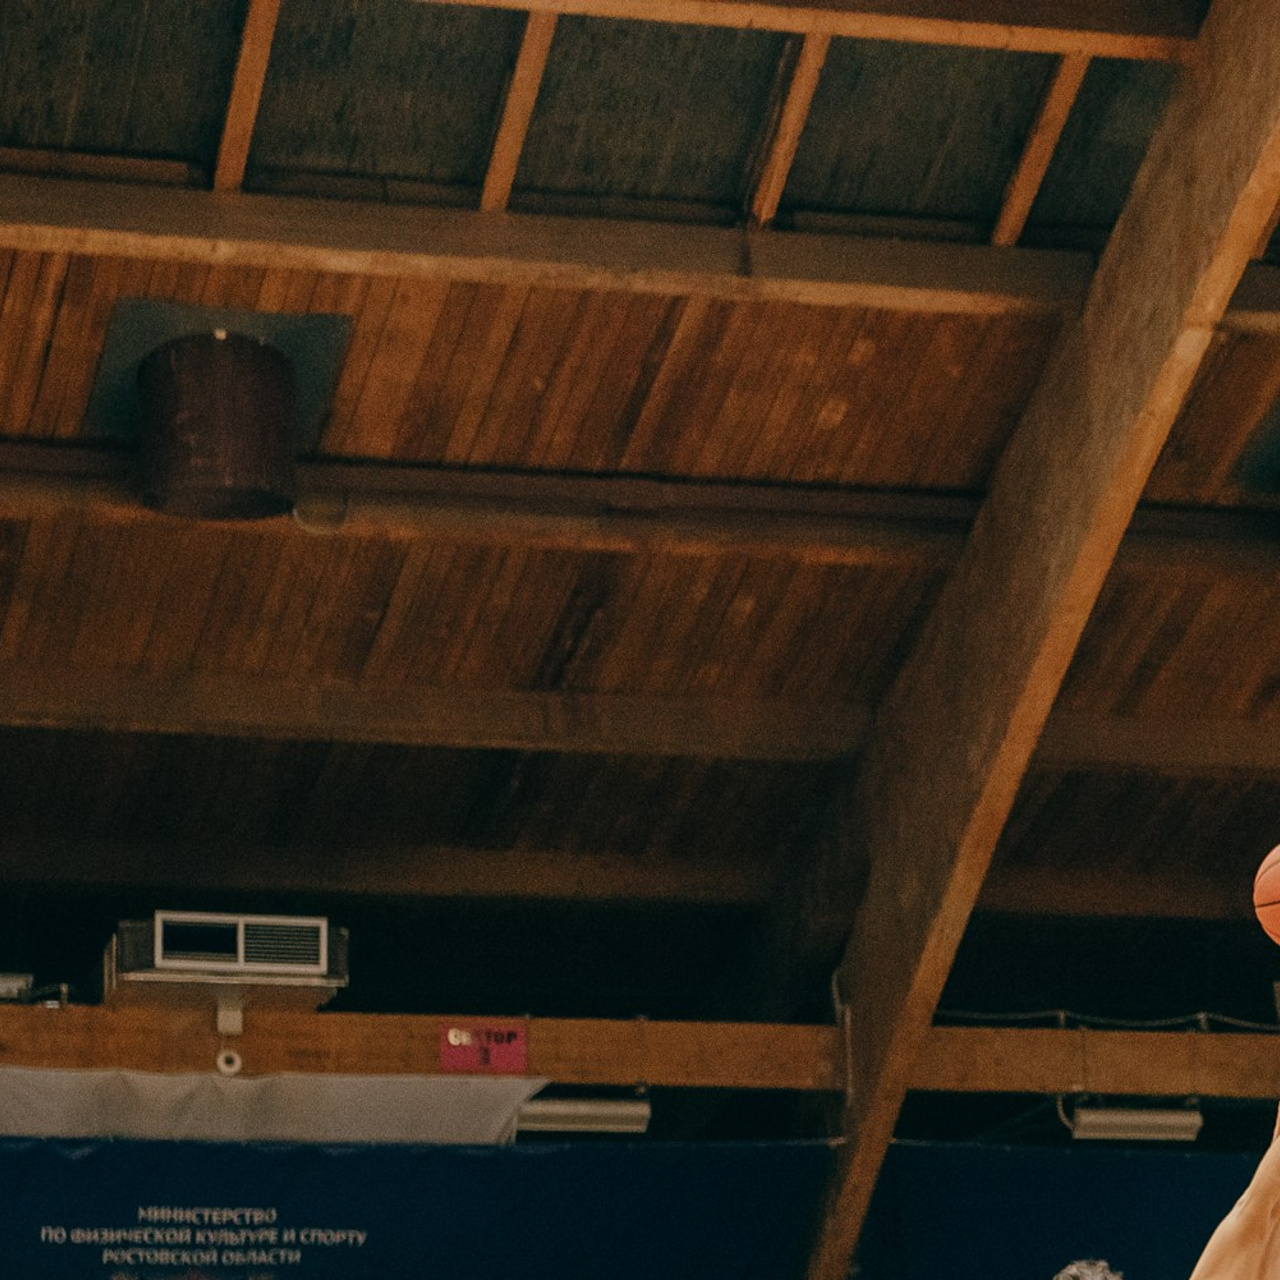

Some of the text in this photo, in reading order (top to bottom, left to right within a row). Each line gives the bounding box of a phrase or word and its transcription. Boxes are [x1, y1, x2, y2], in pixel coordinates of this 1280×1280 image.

[137, 1207, 277, 1225] МИНИСТЕРСТВО
[41, 1226, 367, 1247] ПО ФИЗИЧЕСКОЙ КУЛЬТУРЕ И СПОРТУ
[102, 1248, 302, 1266] РОСТОВСКОЙ ОБЛАСТИ
